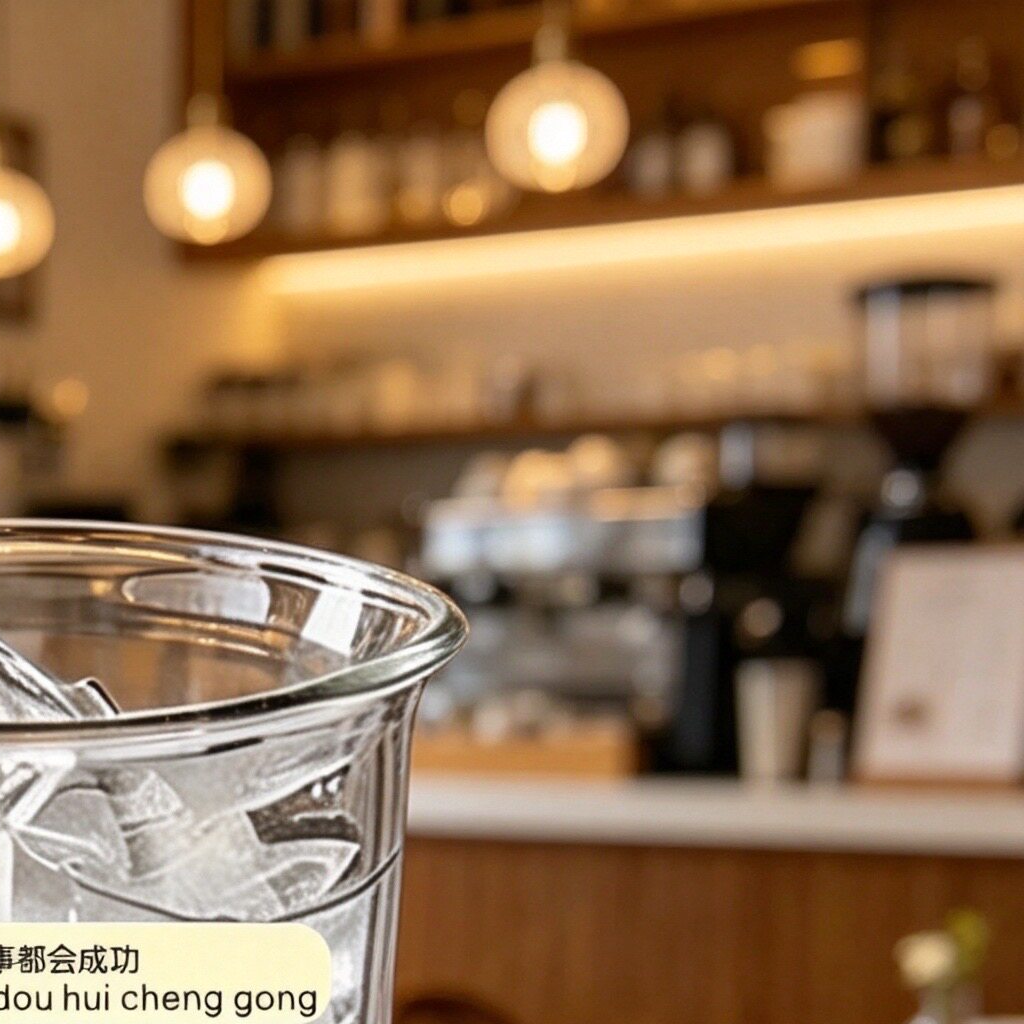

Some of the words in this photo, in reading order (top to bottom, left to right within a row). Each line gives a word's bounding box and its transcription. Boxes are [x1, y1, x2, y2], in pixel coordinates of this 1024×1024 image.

[63, 983, 110, 1011] hui
[121, 983, 223, 1018] cheng
[233, 990, 317, 1018] gong
